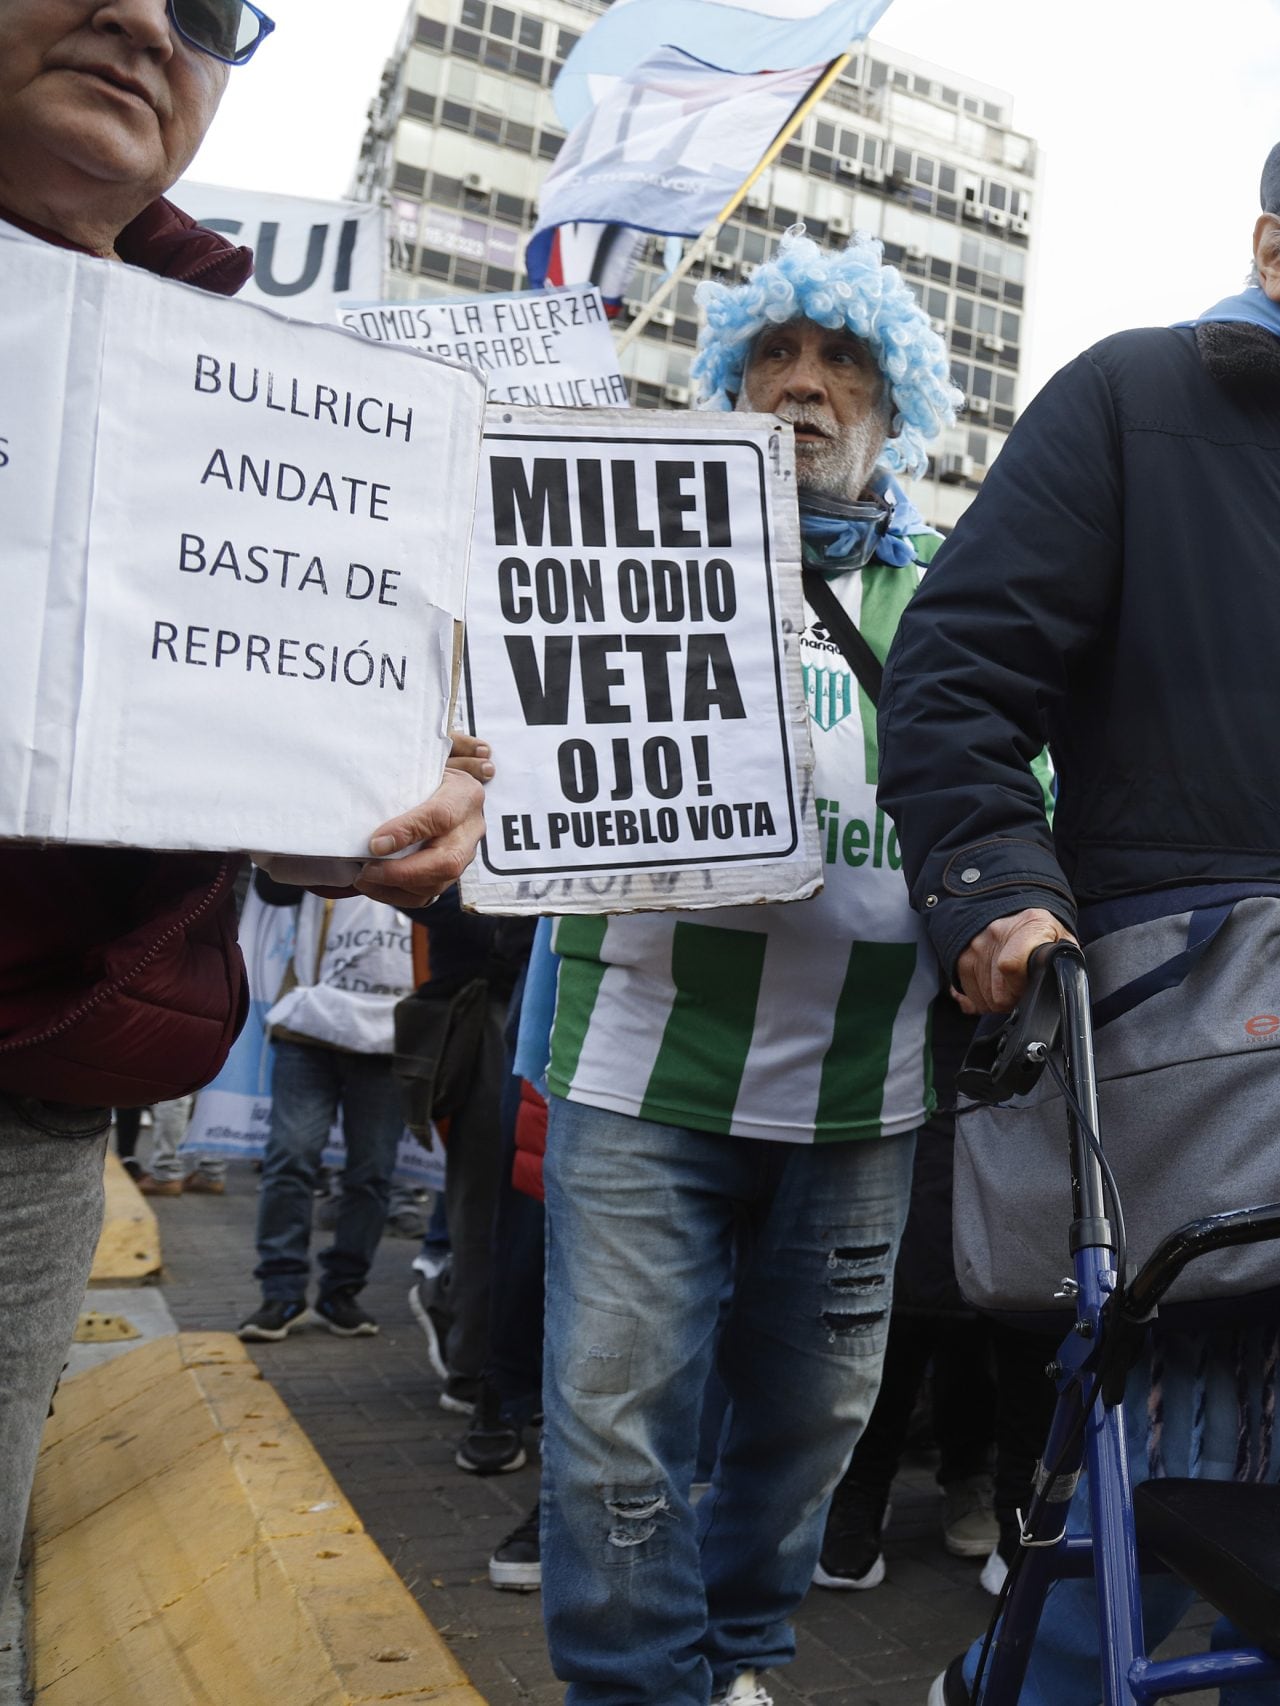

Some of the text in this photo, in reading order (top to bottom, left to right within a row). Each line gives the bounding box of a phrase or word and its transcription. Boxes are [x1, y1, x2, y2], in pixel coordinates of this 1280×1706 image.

[343, 309, 431, 341] SOMOS
[493, 293, 602, 332] FUERZA
[194, 353, 413, 442] BULLRICH
[200, 449, 391, 521] ANDATE
[489, 455, 732, 548] MILEI
[179, 533, 401, 607] BASTA DE
[498, 557, 737, 625] CON ODIO
[151, 621, 407, 691] REPRESIÓN
[504, 633, 747, 726] VETA
[557, 735, 713, 804] OJO!
[501, 801, 777, 852] EL PUEBLO VOTA
